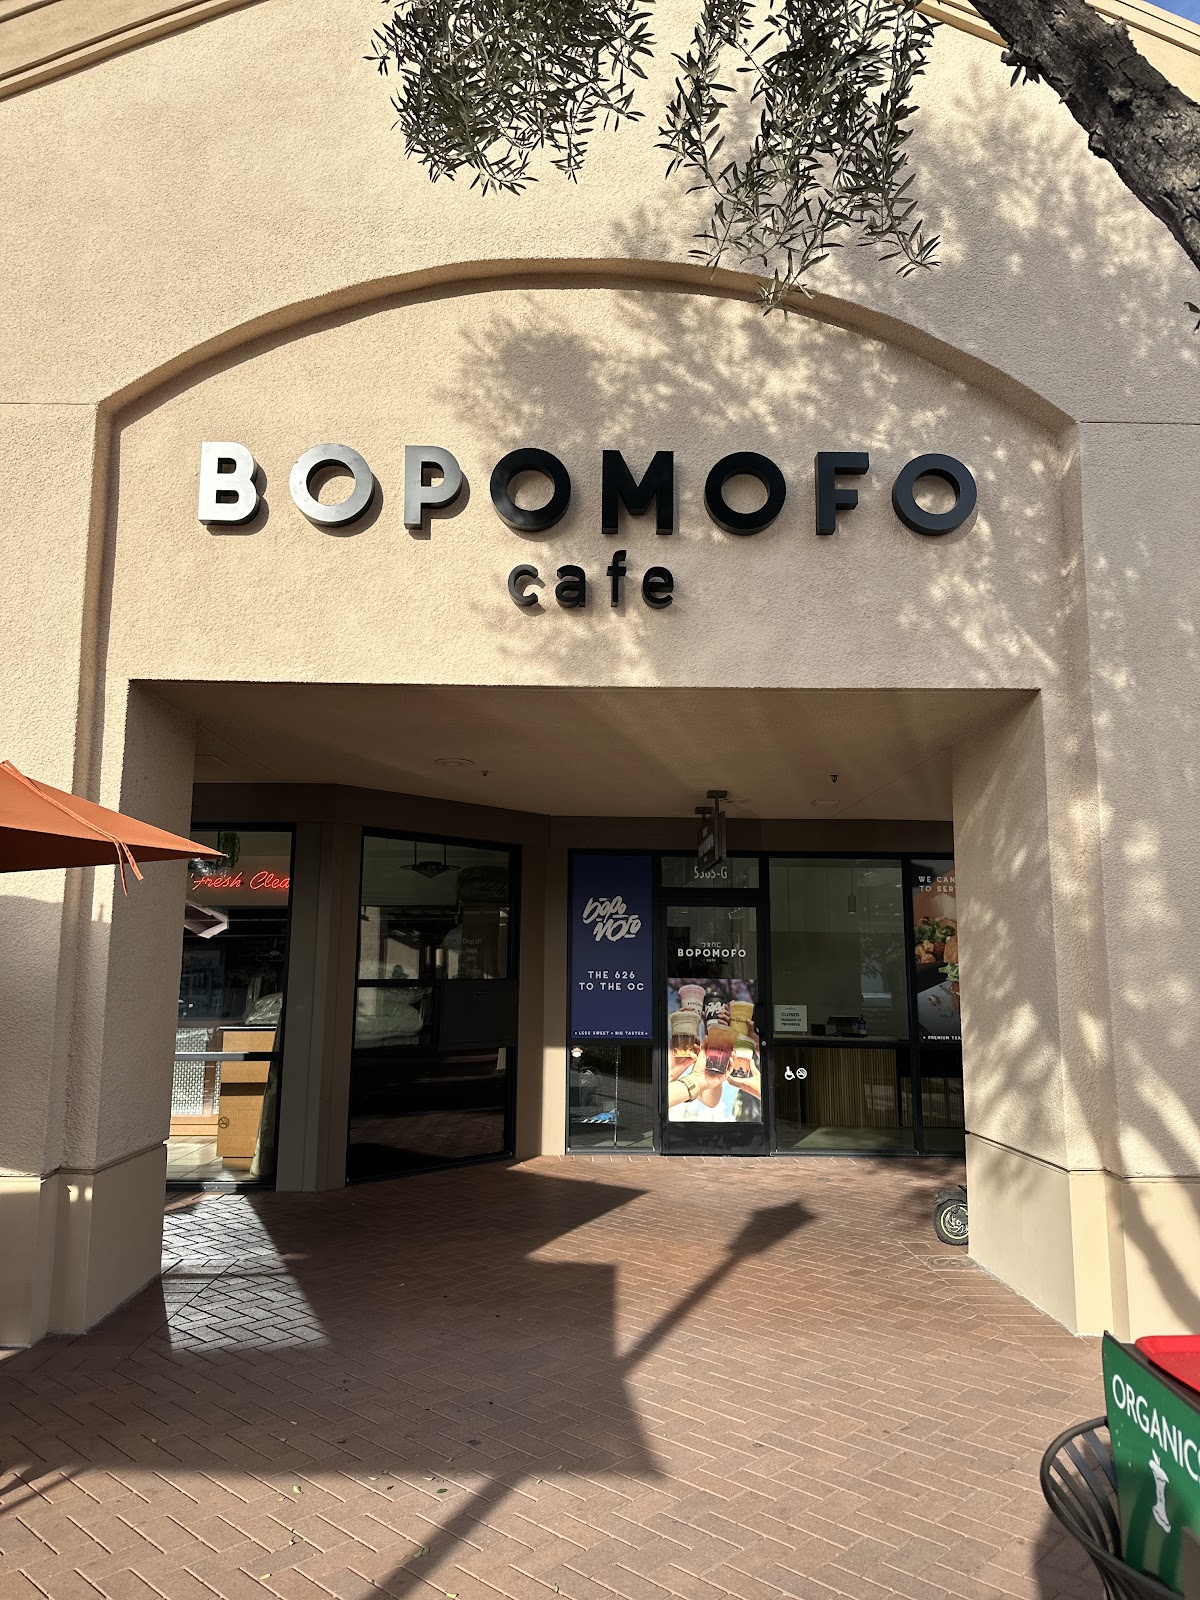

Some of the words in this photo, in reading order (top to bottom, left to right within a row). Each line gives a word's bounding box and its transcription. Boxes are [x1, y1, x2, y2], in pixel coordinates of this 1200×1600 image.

[197, 441, 978, 537] BOPOMOFO
[507, 550, 676, 609] cafe
[677, 948, 747, 958] BOPOMOFO
[579, 982, 594, 991] TO
[600, 982, 622, 991] THE
[627, 982, 645, 991] OC
[587, 970, 609, 979] THE
[614, 970, 636, 979] 626
[1112, 1373, 1200, 1485] ORGANIC
